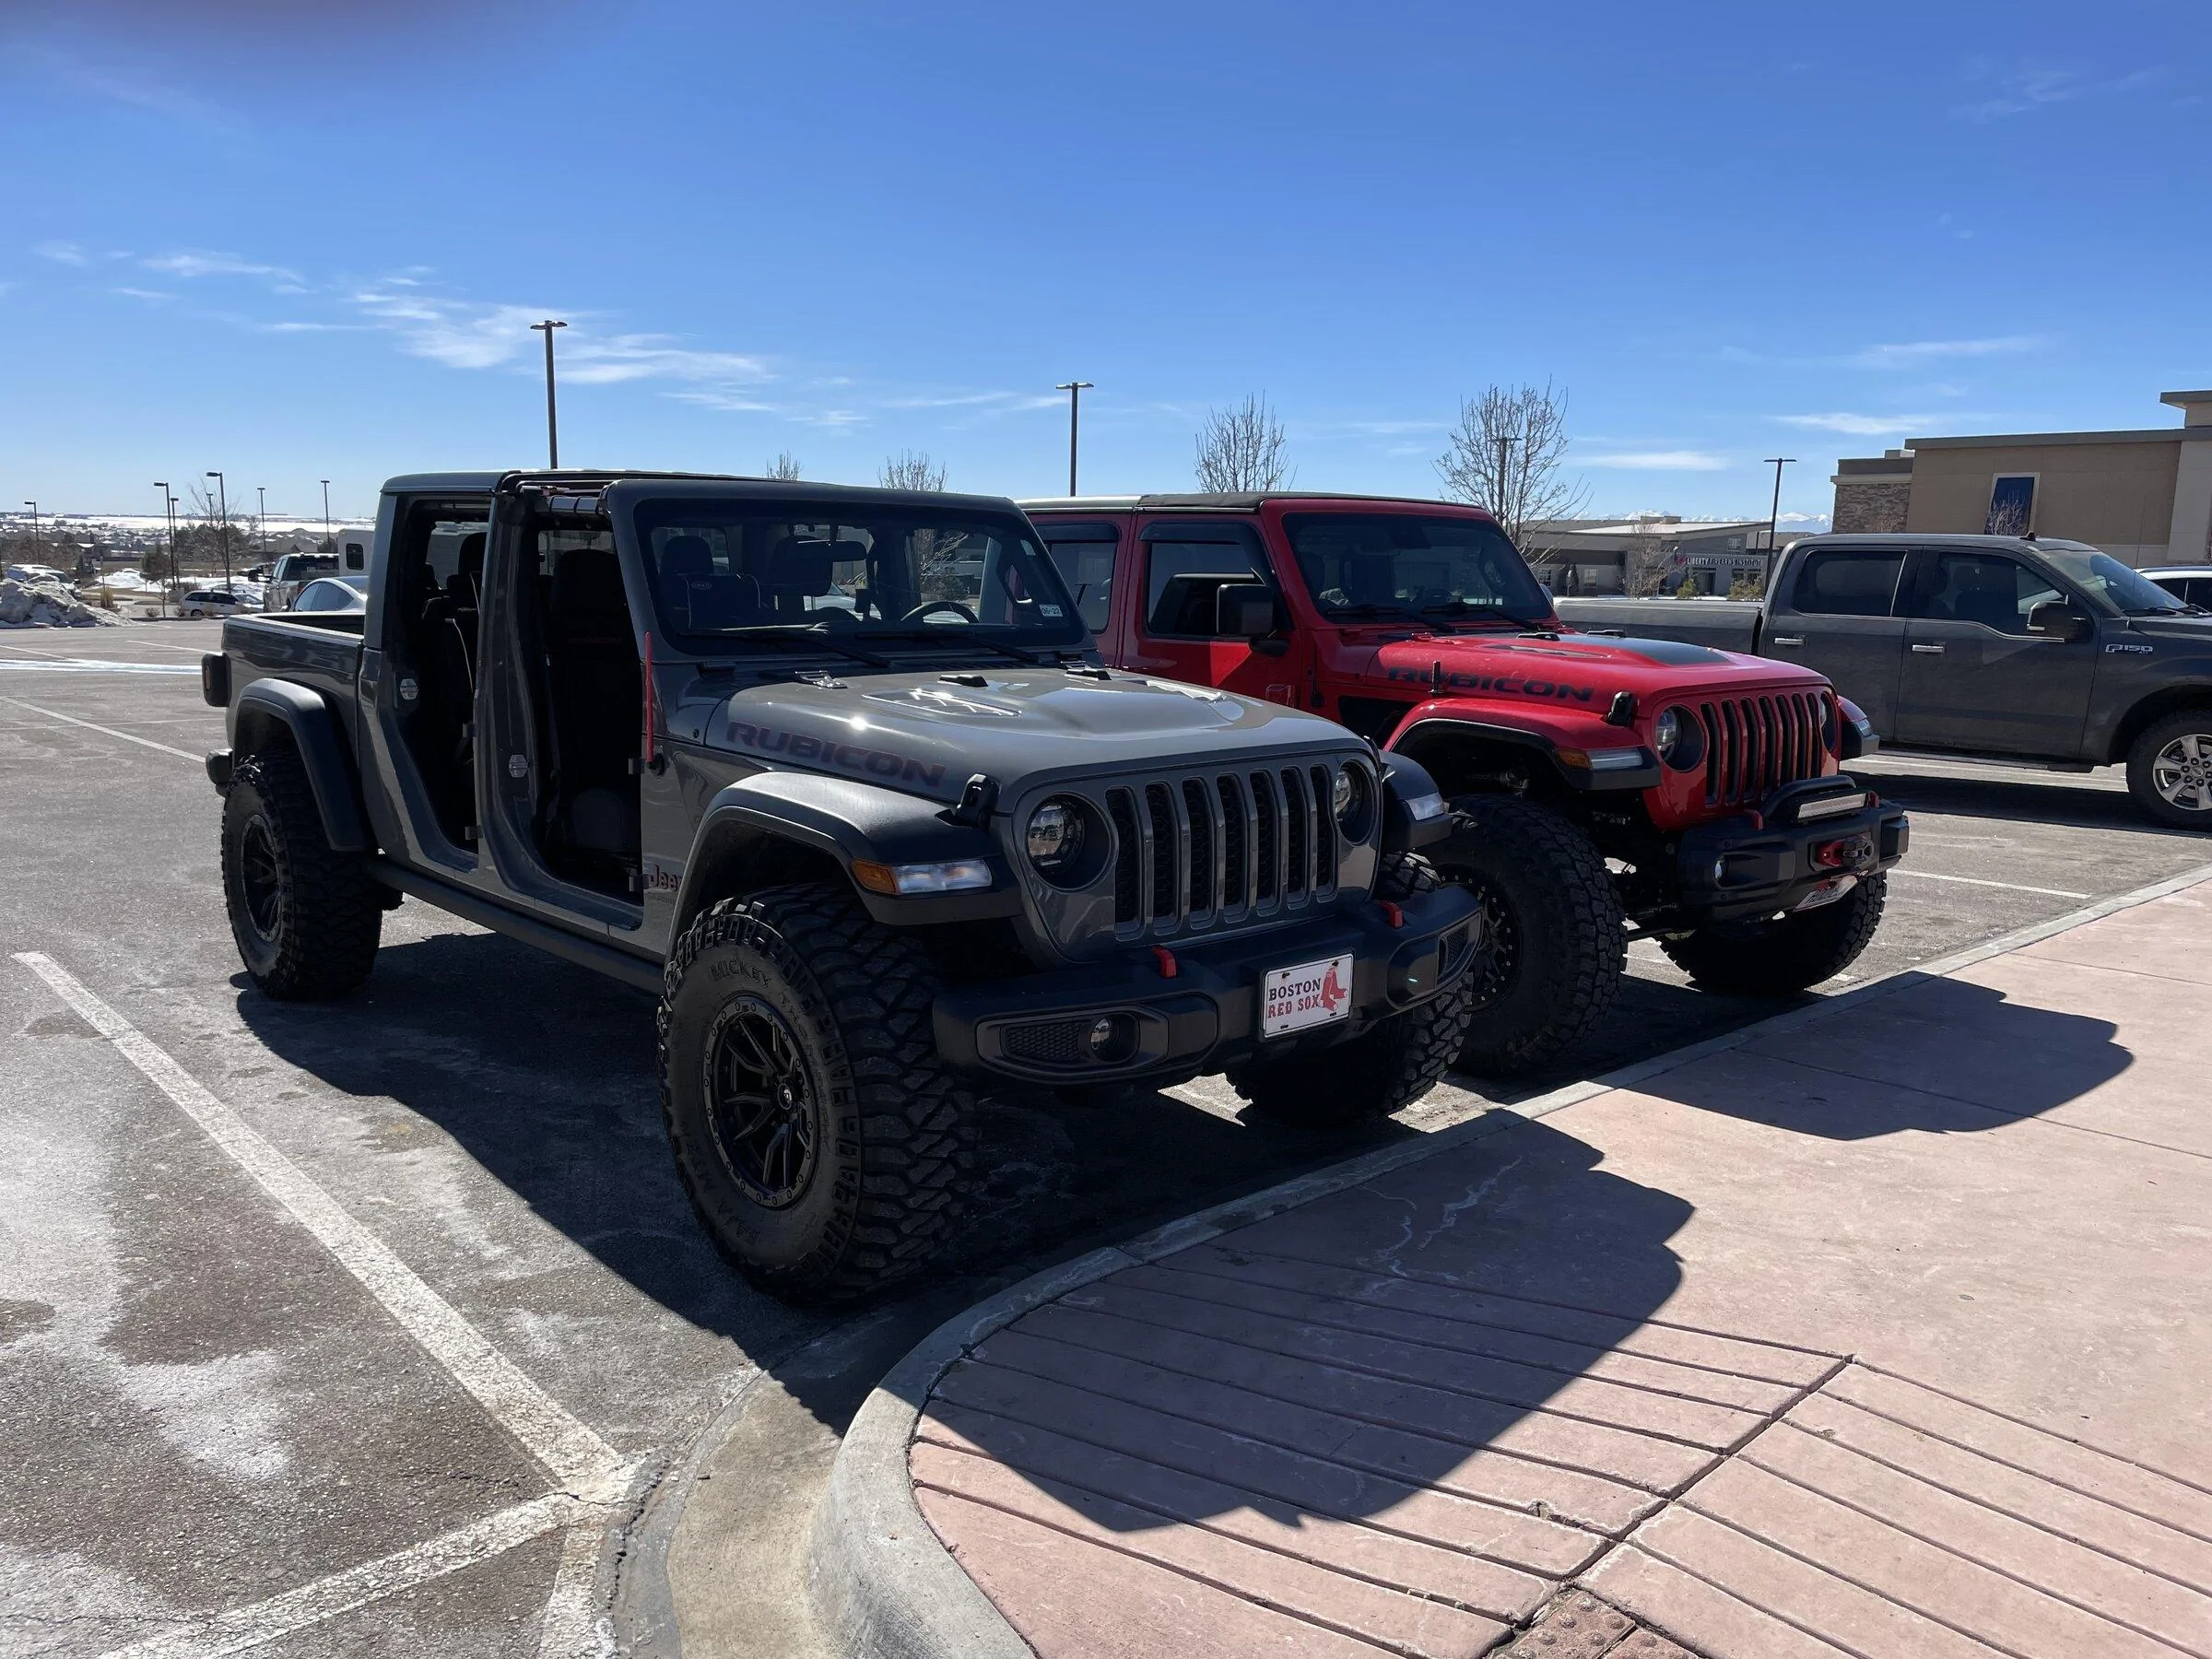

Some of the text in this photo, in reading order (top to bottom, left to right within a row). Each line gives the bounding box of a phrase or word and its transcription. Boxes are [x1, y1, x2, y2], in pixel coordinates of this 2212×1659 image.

[1687, 557, 1708, 565] LIBERTY
[1387, 665, 1595, 702] RUBICON
[726, 720, 947, 788] RUBICON
[709, 958, 773, 989] MICKEY
[1268, 978, 1322, 1002] BOSTON
[1267, 994, 1320, 1019] RED SOX
